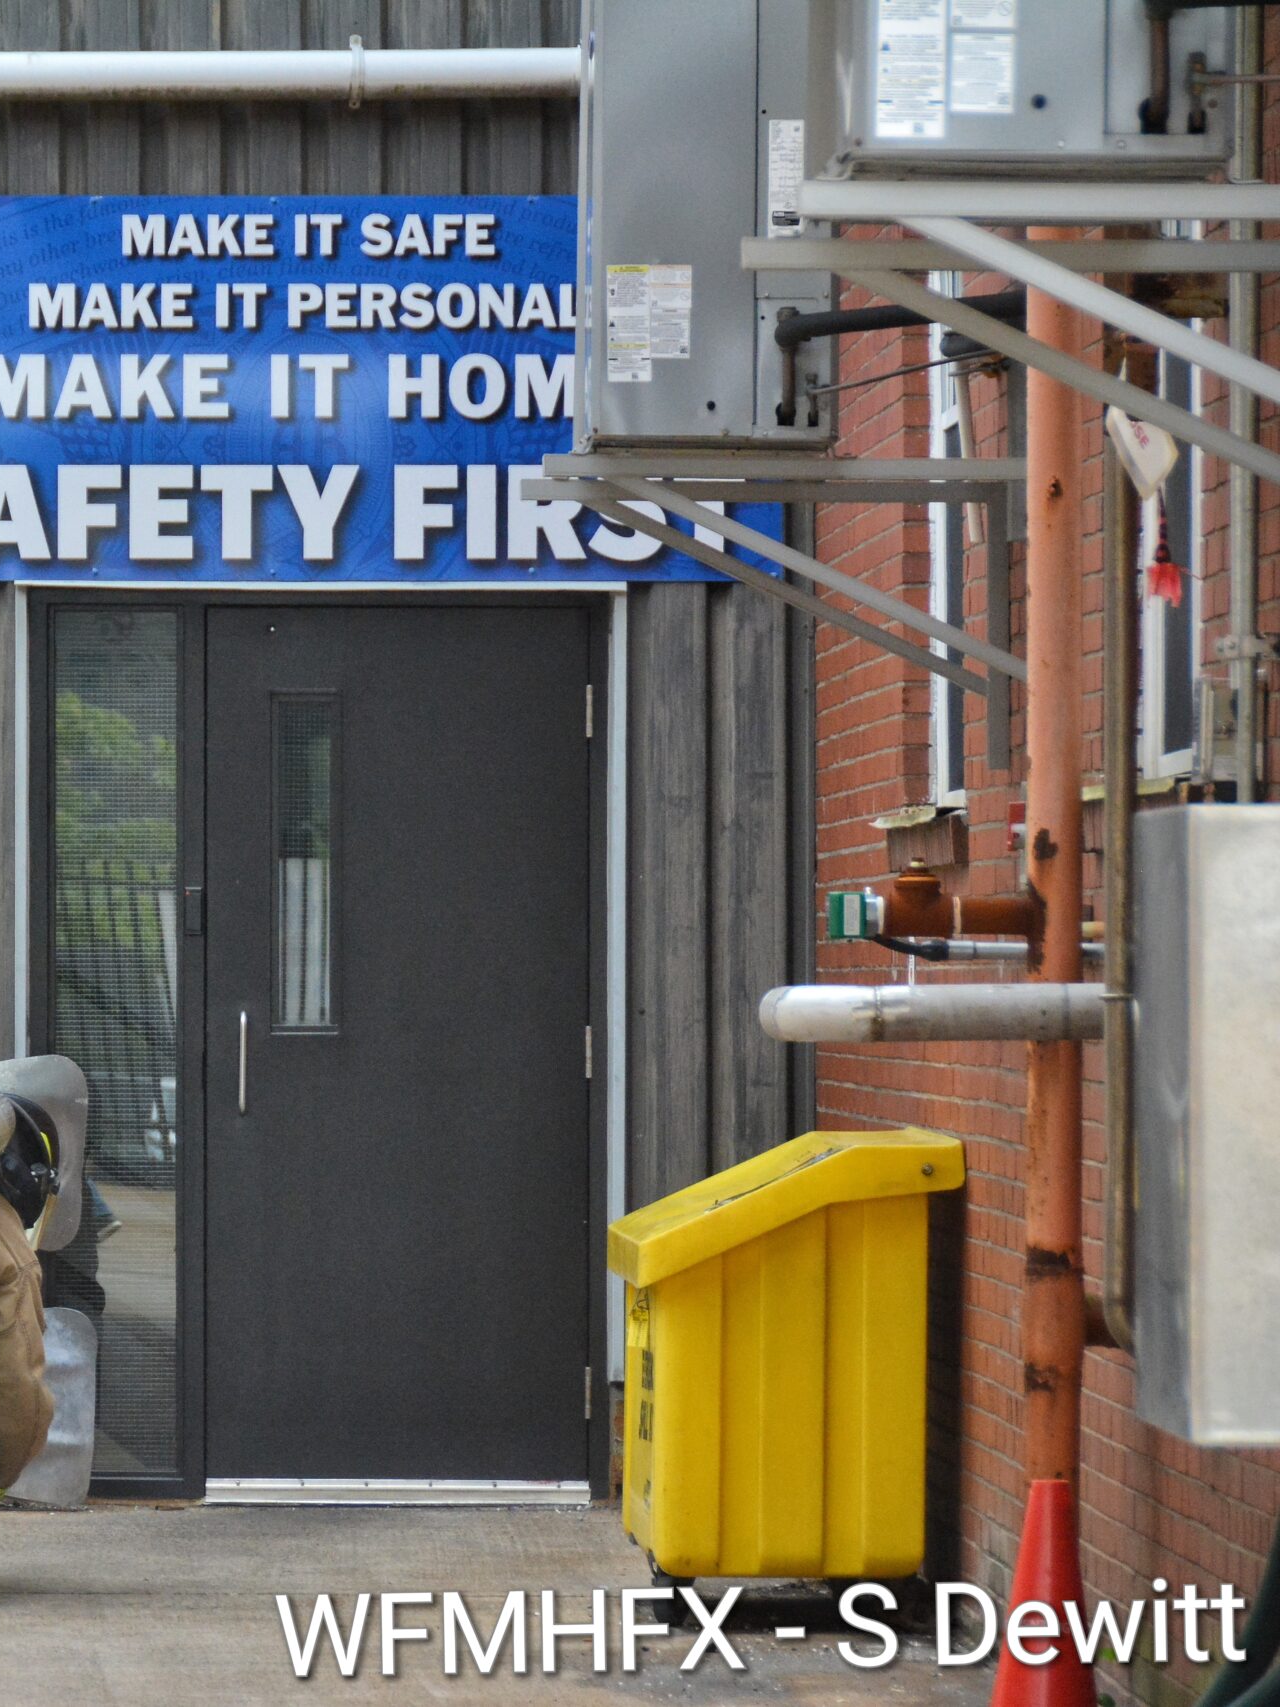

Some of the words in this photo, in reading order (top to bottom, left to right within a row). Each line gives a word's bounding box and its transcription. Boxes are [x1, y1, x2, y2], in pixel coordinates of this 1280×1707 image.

[123, 213, 274, 256] MAKE
[294, 214, 342, 256] IT
[361, 213, 495, 256] SAFE
[28, 283, 193, 328] MAKE
[215, 283, 267, 328] IT
[287, 283, 577, 329] PERSONAL
[270, 353, 349, 419] IT
[388, 353, 576, 419] HOM
